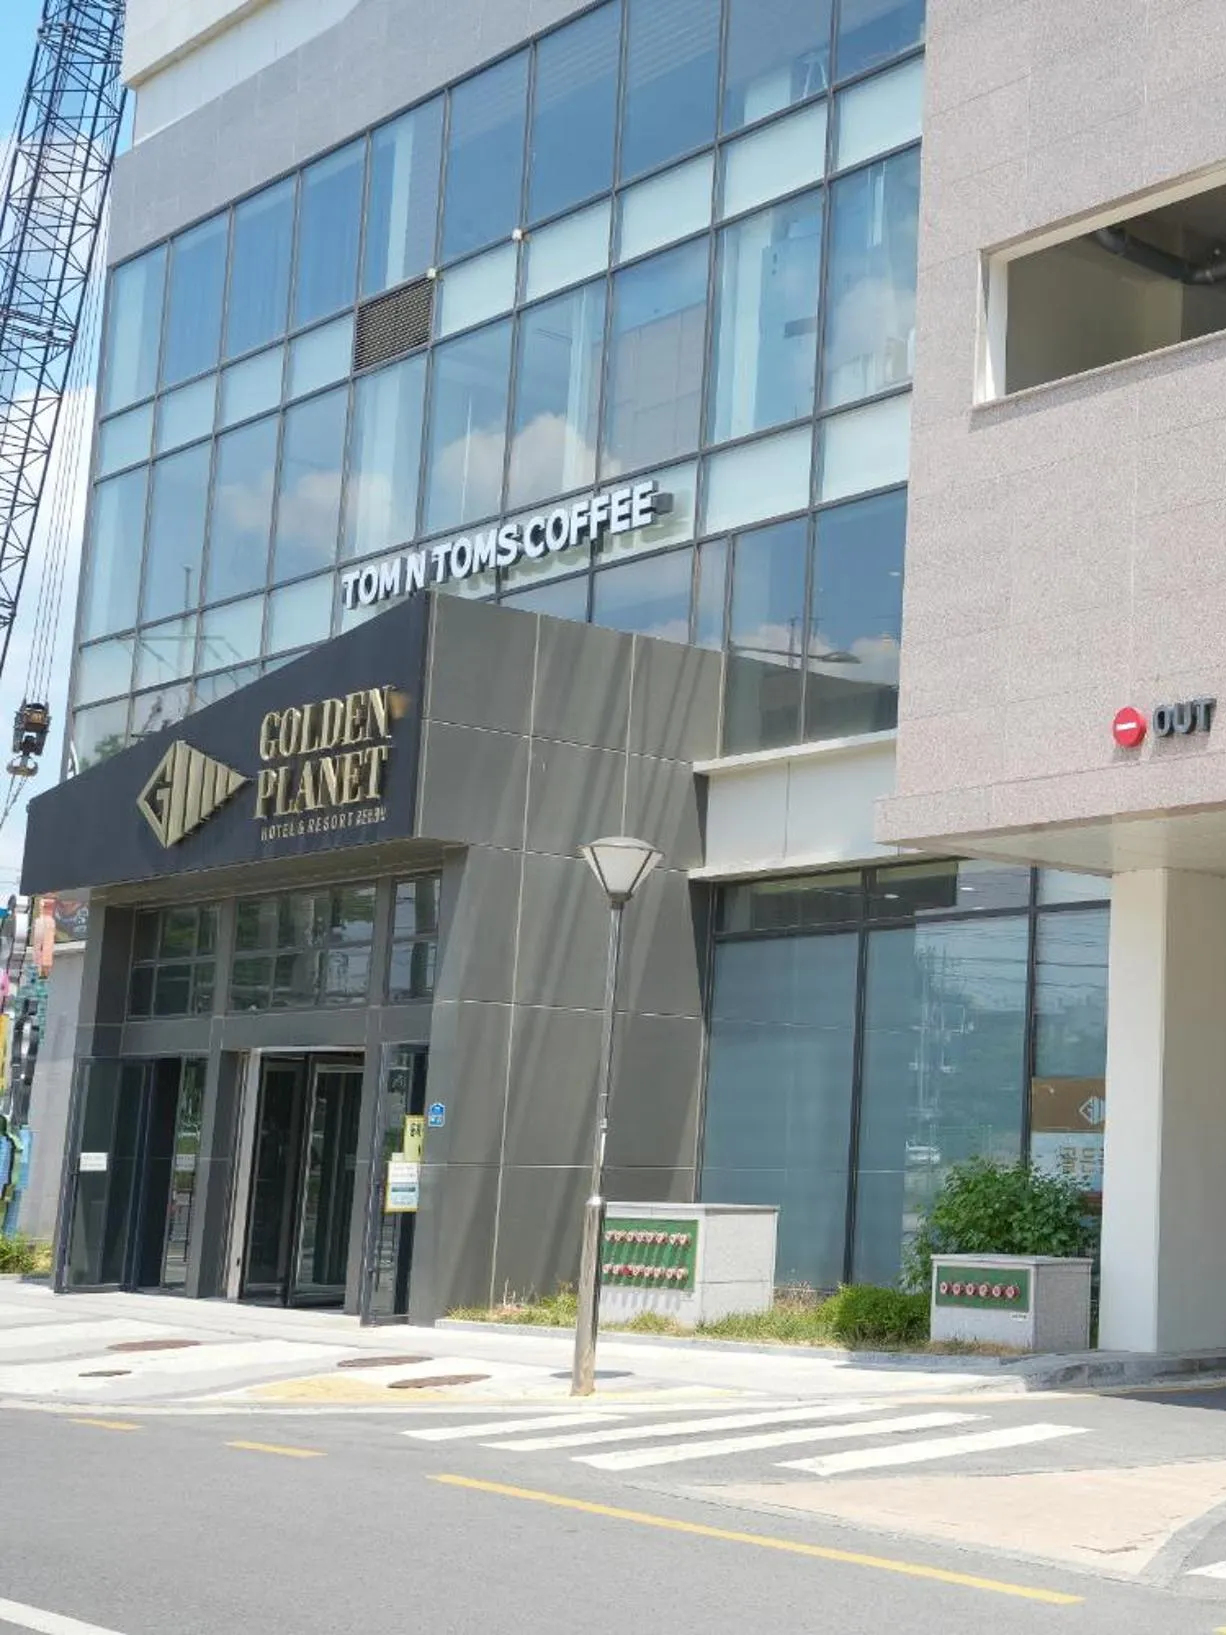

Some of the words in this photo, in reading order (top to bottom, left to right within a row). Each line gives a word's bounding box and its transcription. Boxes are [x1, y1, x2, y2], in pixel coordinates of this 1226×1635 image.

[342, 557, 400, 609] TOM
[405, 550, 427, 592] N
[432, 523, 519, 583] TOMS
[523, 479, 658, 559] COFFEE
[259, 684, 396, 760] GOLDEN
[1152, 697, 1217, 737] OUT
[253, 745, 394, 819] PLANET
[260, 822, 296, 841] HOTEL
[307, 811, 354, 833] RESORT
